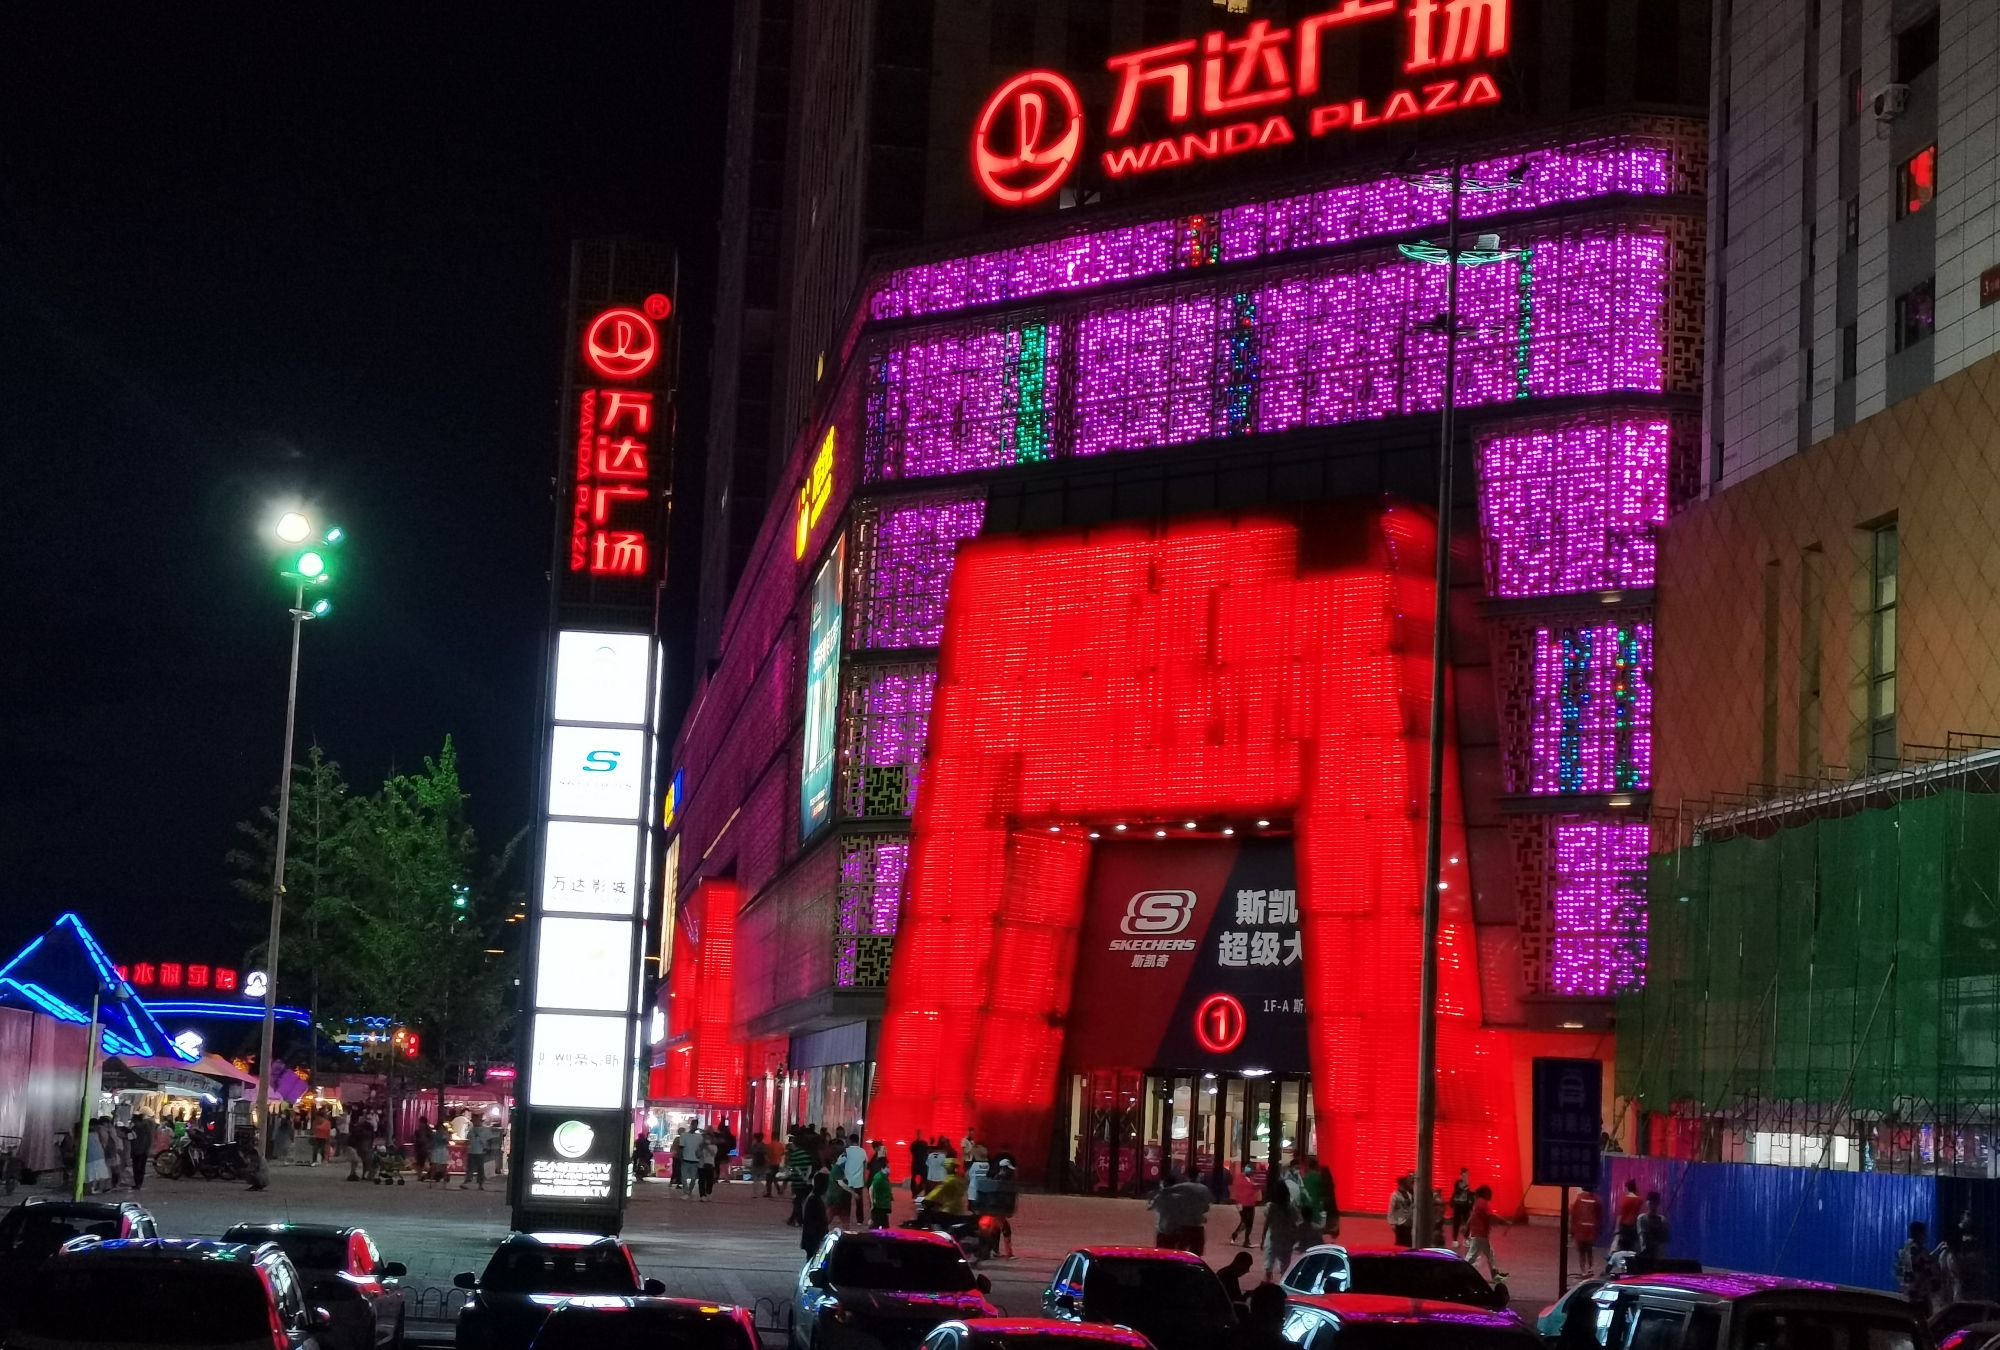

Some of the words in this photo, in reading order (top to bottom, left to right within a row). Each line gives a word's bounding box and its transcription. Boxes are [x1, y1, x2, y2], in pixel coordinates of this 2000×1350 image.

[1106, 0, 1512, 137] 万达广场
[1104, 114, 1295, 178] WANDA
[1309, 73, 1503, 137] PLAZA
[577, 388, 597, 482] WANDA
[589, 389, 654, 575] 万达广场
[570, 484, 591, 572] PLAZA
[1108, 938, 1197, 952] SKECHERS
[1130, 953, 1169, 969] 斯凯奇
[1218, 930, 1303, 968] 超级大
[1263, 999, 1290, 1013] 1F-A
